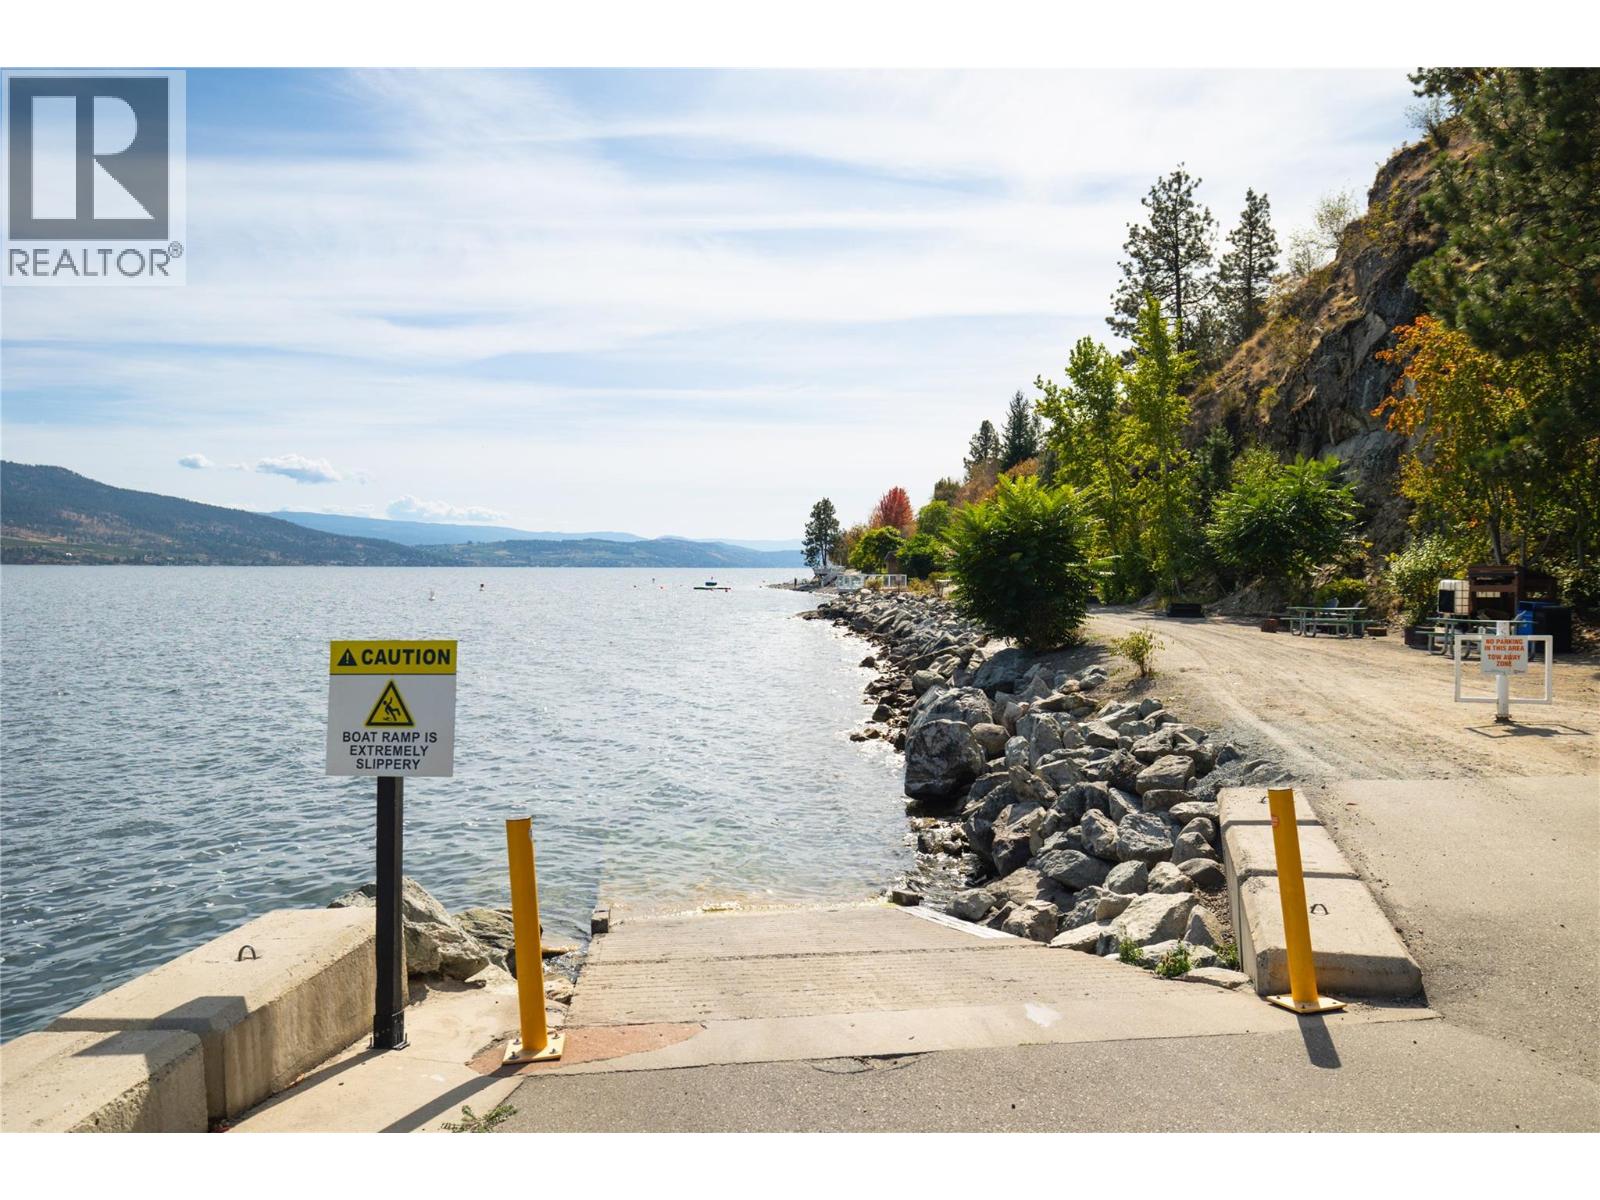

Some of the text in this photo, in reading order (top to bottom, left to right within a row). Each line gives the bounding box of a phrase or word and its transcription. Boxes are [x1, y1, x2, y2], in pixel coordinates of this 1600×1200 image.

[361, 649, 450, 665] CAUTION
[342, 731, 438, 743] BOAT RAMP IS
[350, 745, 429, 757] EXTREMELY
[356, 758, 421, 770] SLIPPERY
